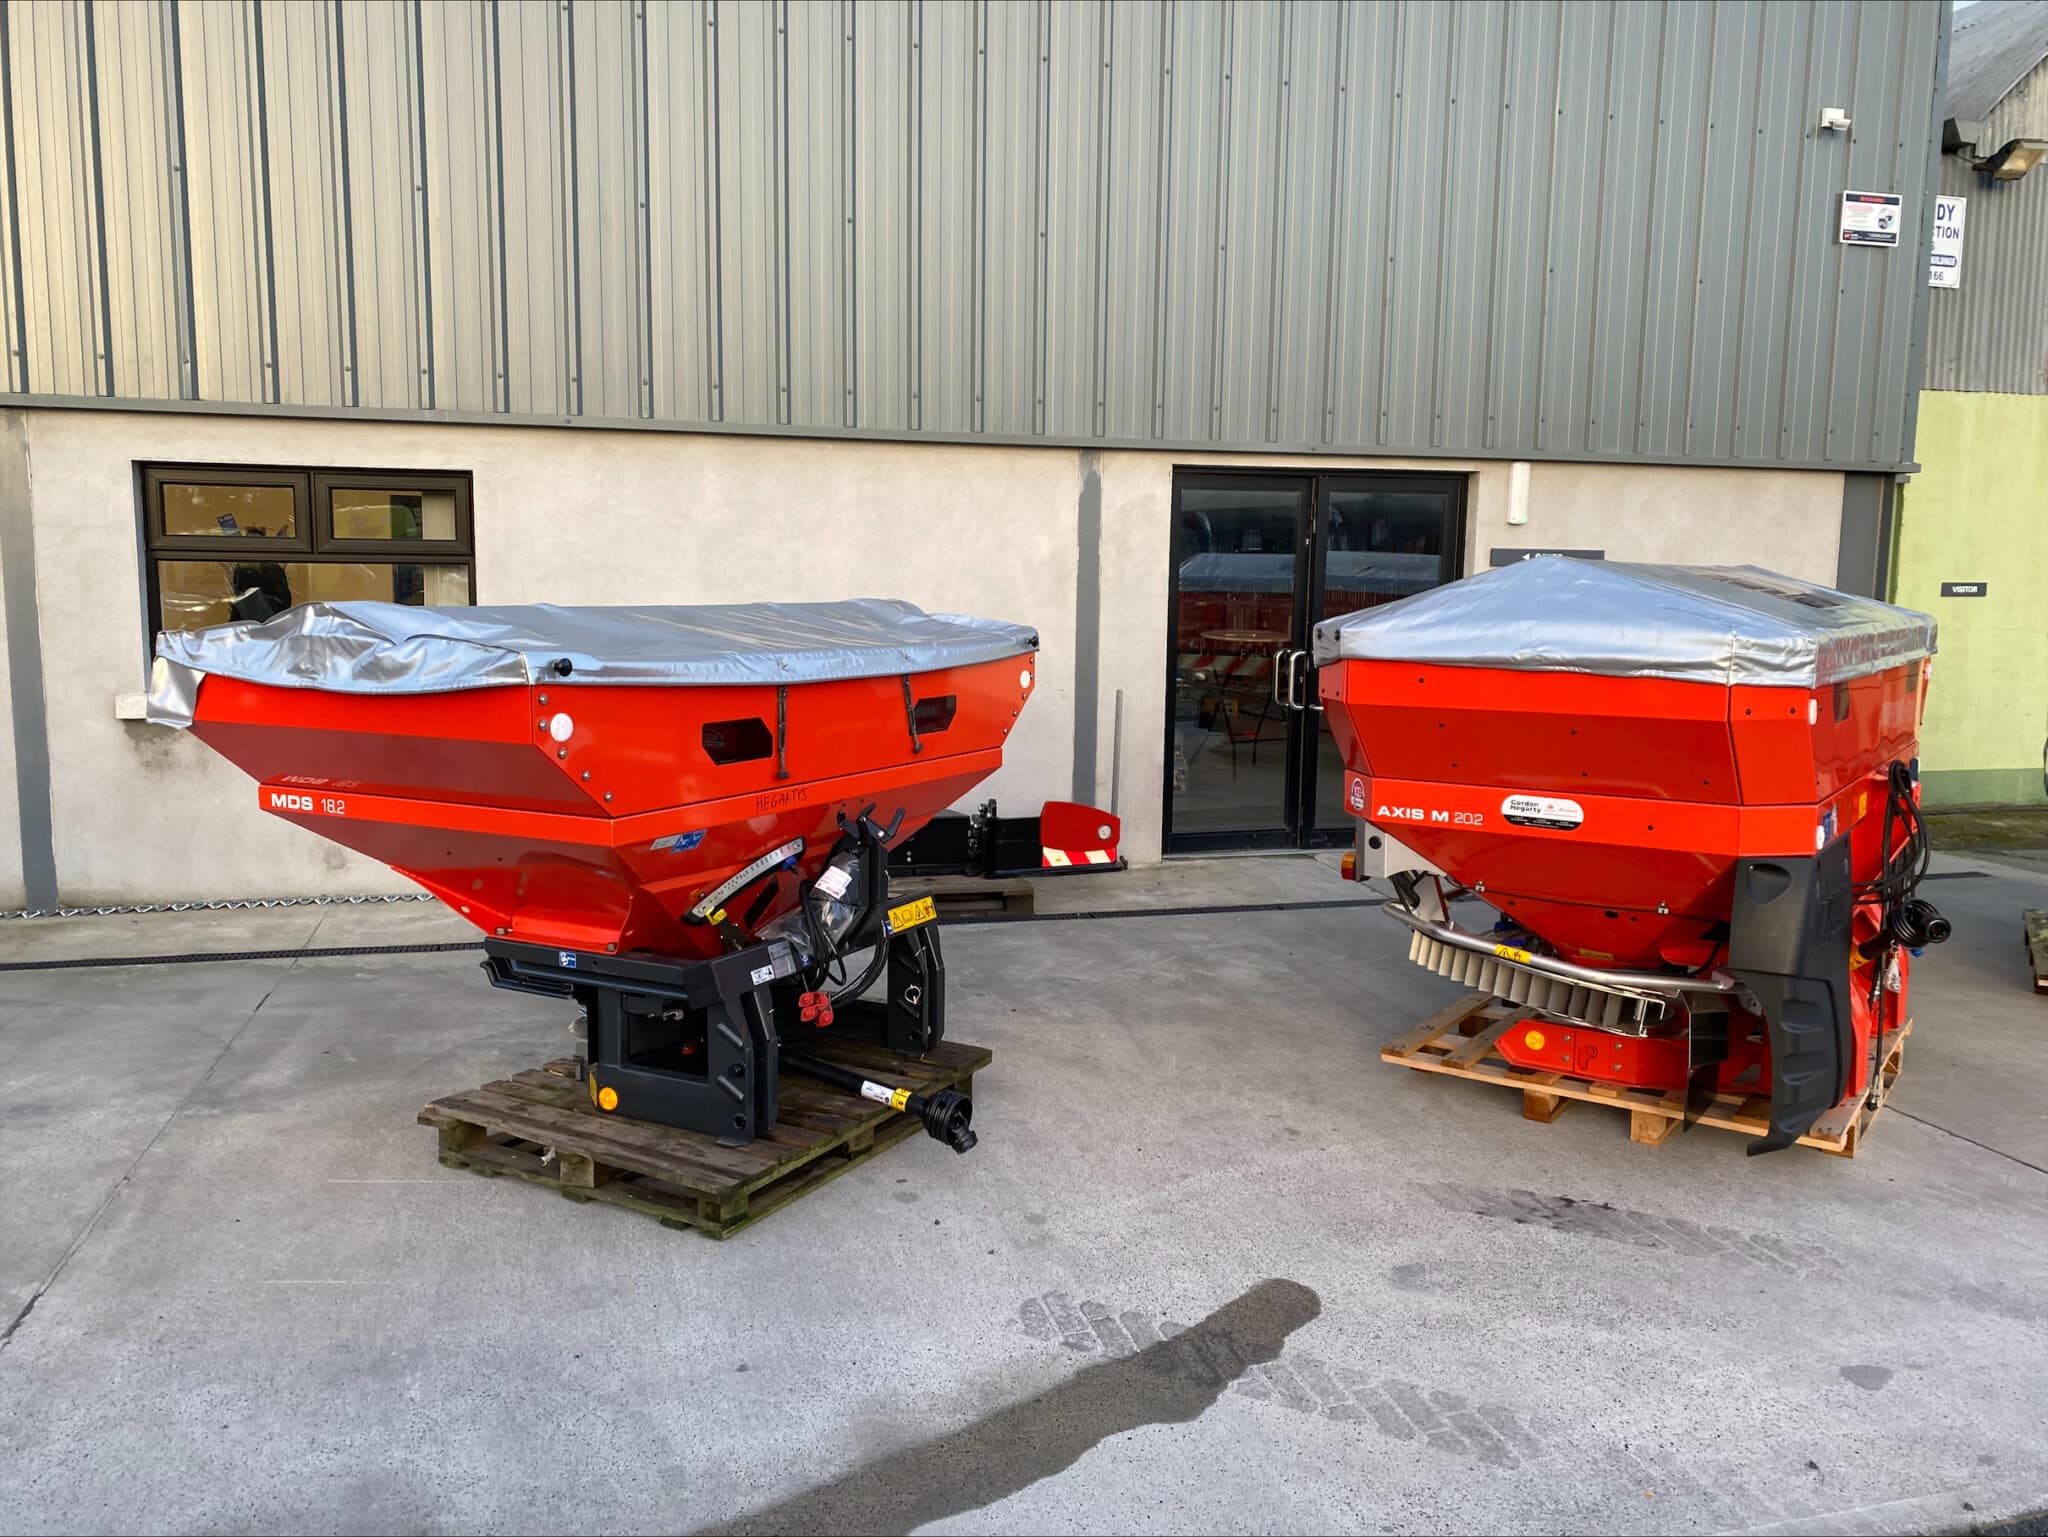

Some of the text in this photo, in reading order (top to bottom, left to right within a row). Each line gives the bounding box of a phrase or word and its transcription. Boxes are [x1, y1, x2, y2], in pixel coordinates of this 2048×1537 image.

[1936, 203, 1956, 221] DY
[1935, 225, 1960, 239] TION
[1952, 585, 1978, 593] VISITOR
[271, 793, 313, 811] MDS
[1510, 799, 1540, 807] Gordon
[1510, 804, 1542, 814] Hegarty
[1377, 805, 1424, 820] AXIS
[1431, 810, 1449, 823] M
